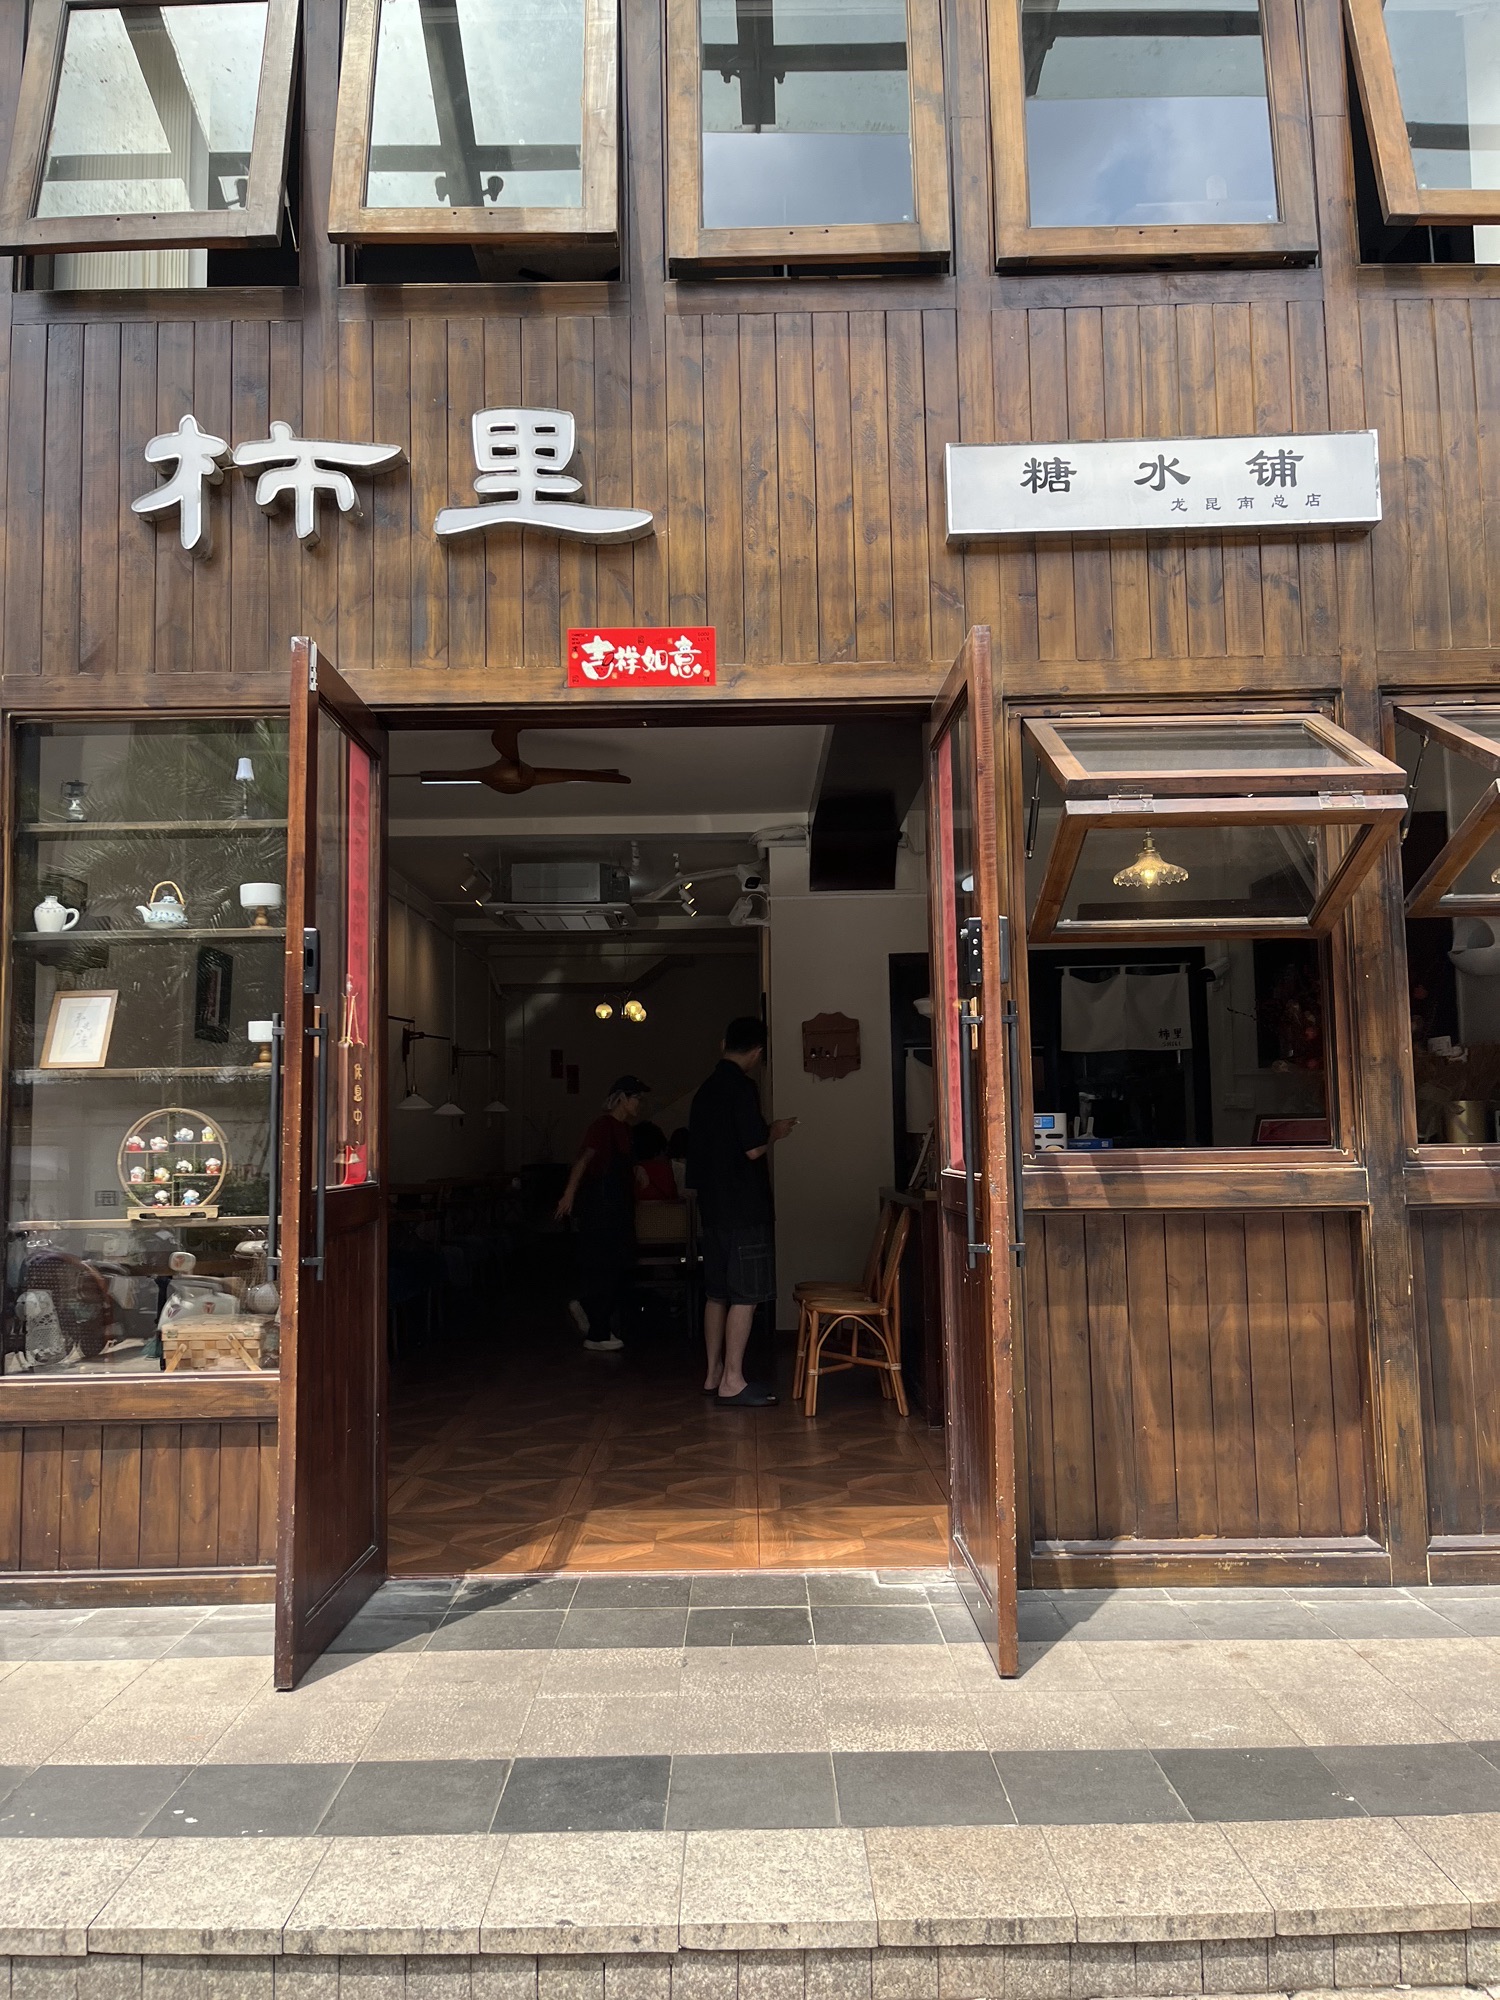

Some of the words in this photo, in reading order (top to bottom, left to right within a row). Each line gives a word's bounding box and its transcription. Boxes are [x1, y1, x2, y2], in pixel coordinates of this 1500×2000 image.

[131, 405, 654, 550] 柿里
[1020, 449, 1304, 494] 糖水铺
[1170, 493, 1322, 512] 龙昆南总店
[581, 635, 703, 680] 吉祥如意
[353, 1063, 363, 1125] 休息中
